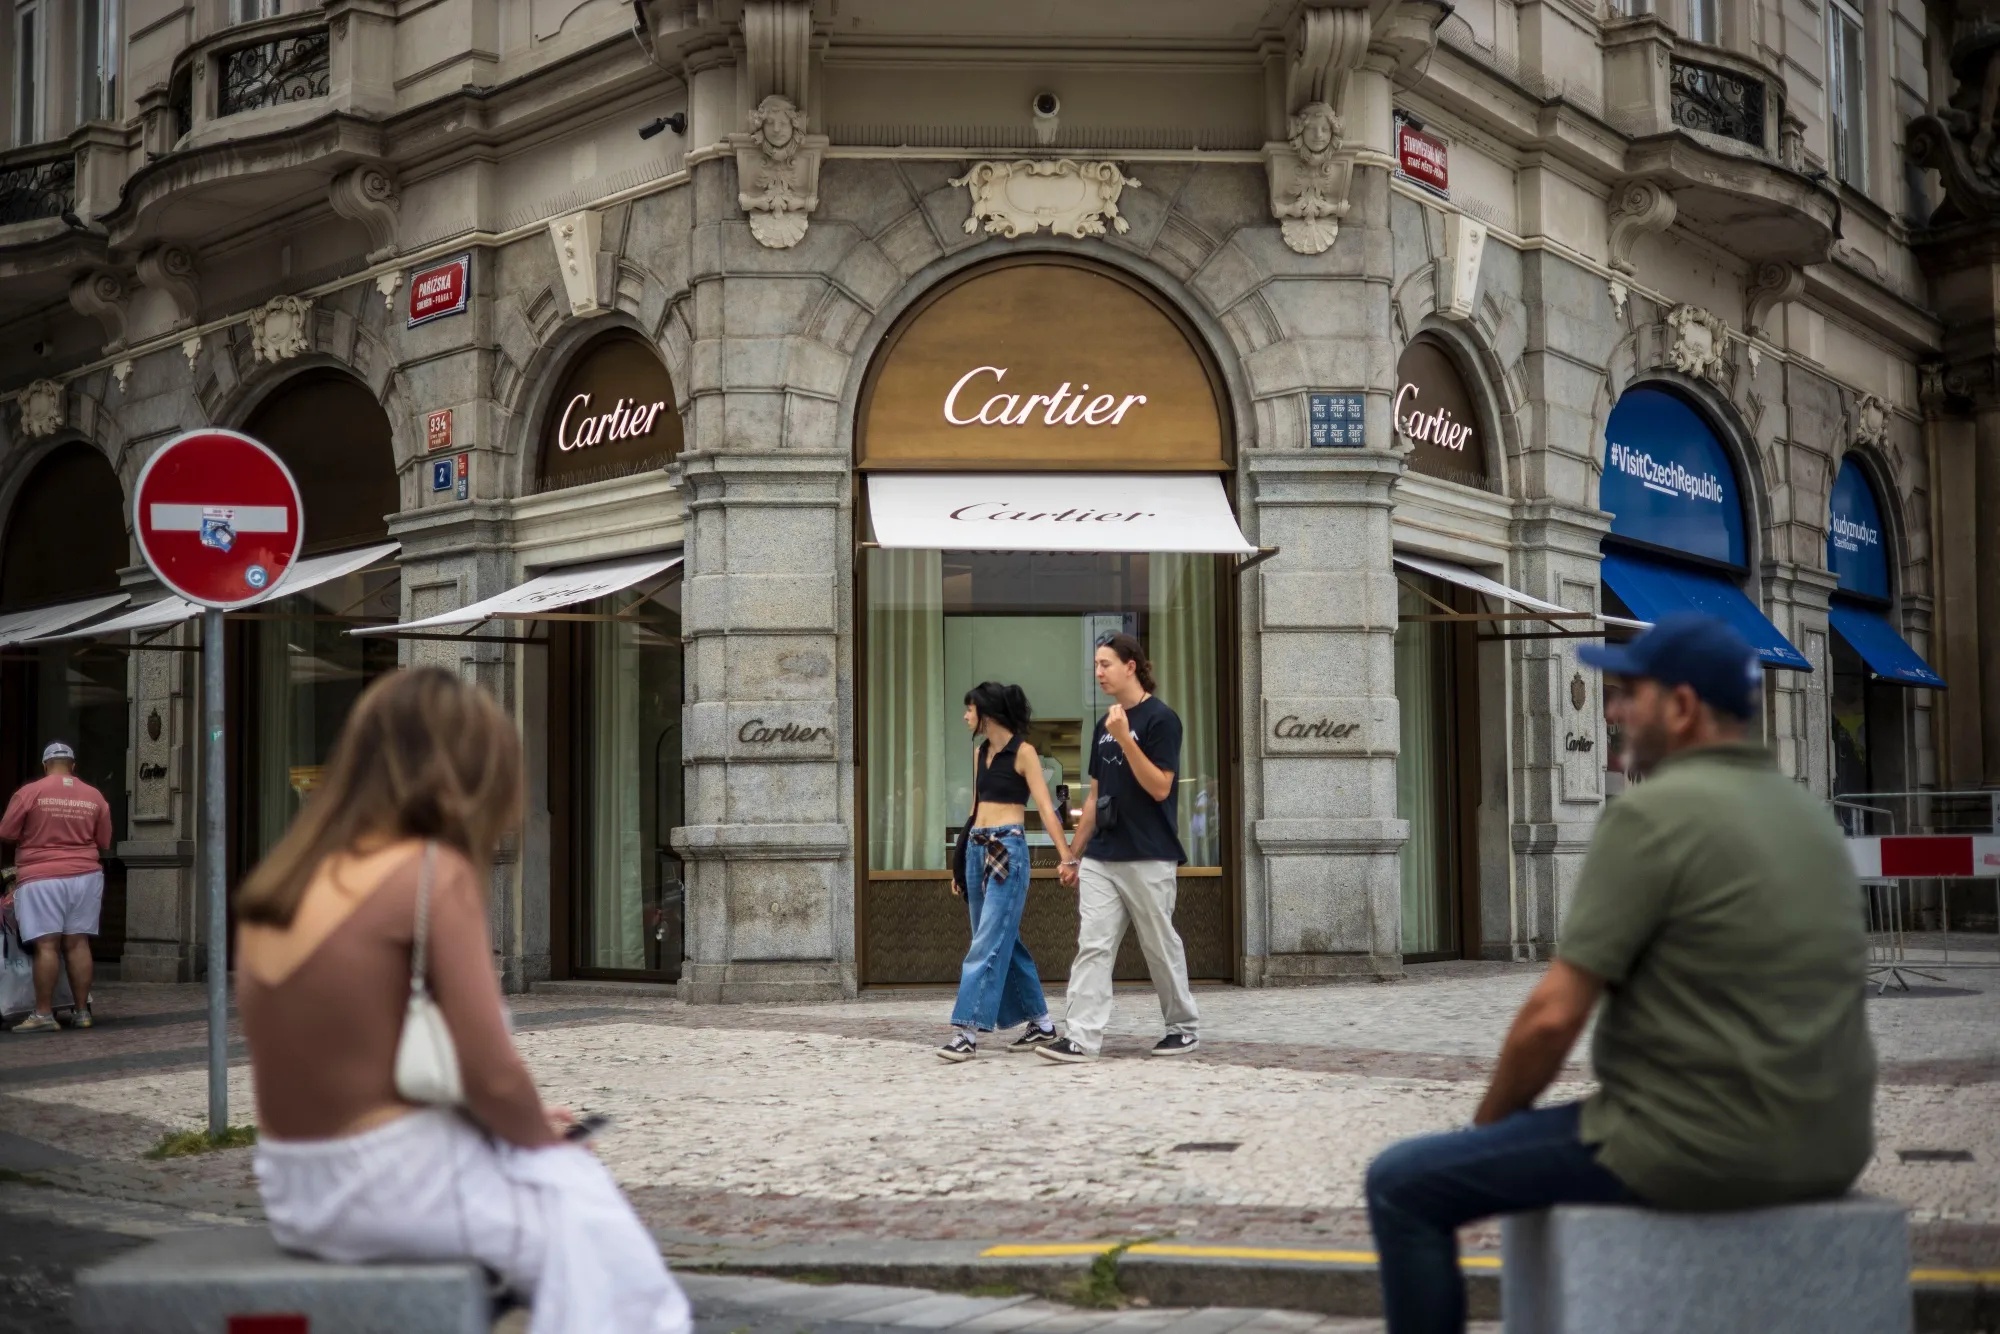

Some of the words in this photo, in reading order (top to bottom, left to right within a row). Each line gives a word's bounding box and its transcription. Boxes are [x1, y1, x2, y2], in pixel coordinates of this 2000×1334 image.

[418, 271, 452, 298] PAŘÍŽSKÁ
[944, 366, 1148, 425] Cartier
[430, 415, 446, 432] 934
[558, 393, 665, 451] Cartier
[1394, 383, 1473, 452] Cartier
[439, 467, 444, 482] 2
[1611, 442, 1723, 503] #VisitCzechRepublic
[949, 502, 1155, 522] Cartier
[1833, 511, 1878, 546] kudyznudy.cz
[738, 718, 827, 743] Cartier
[1274, 715, 1360, 739] Cartier
[1566, 732, 1595, 752] Cartier
[1031, 858, 1060, 867] artier
